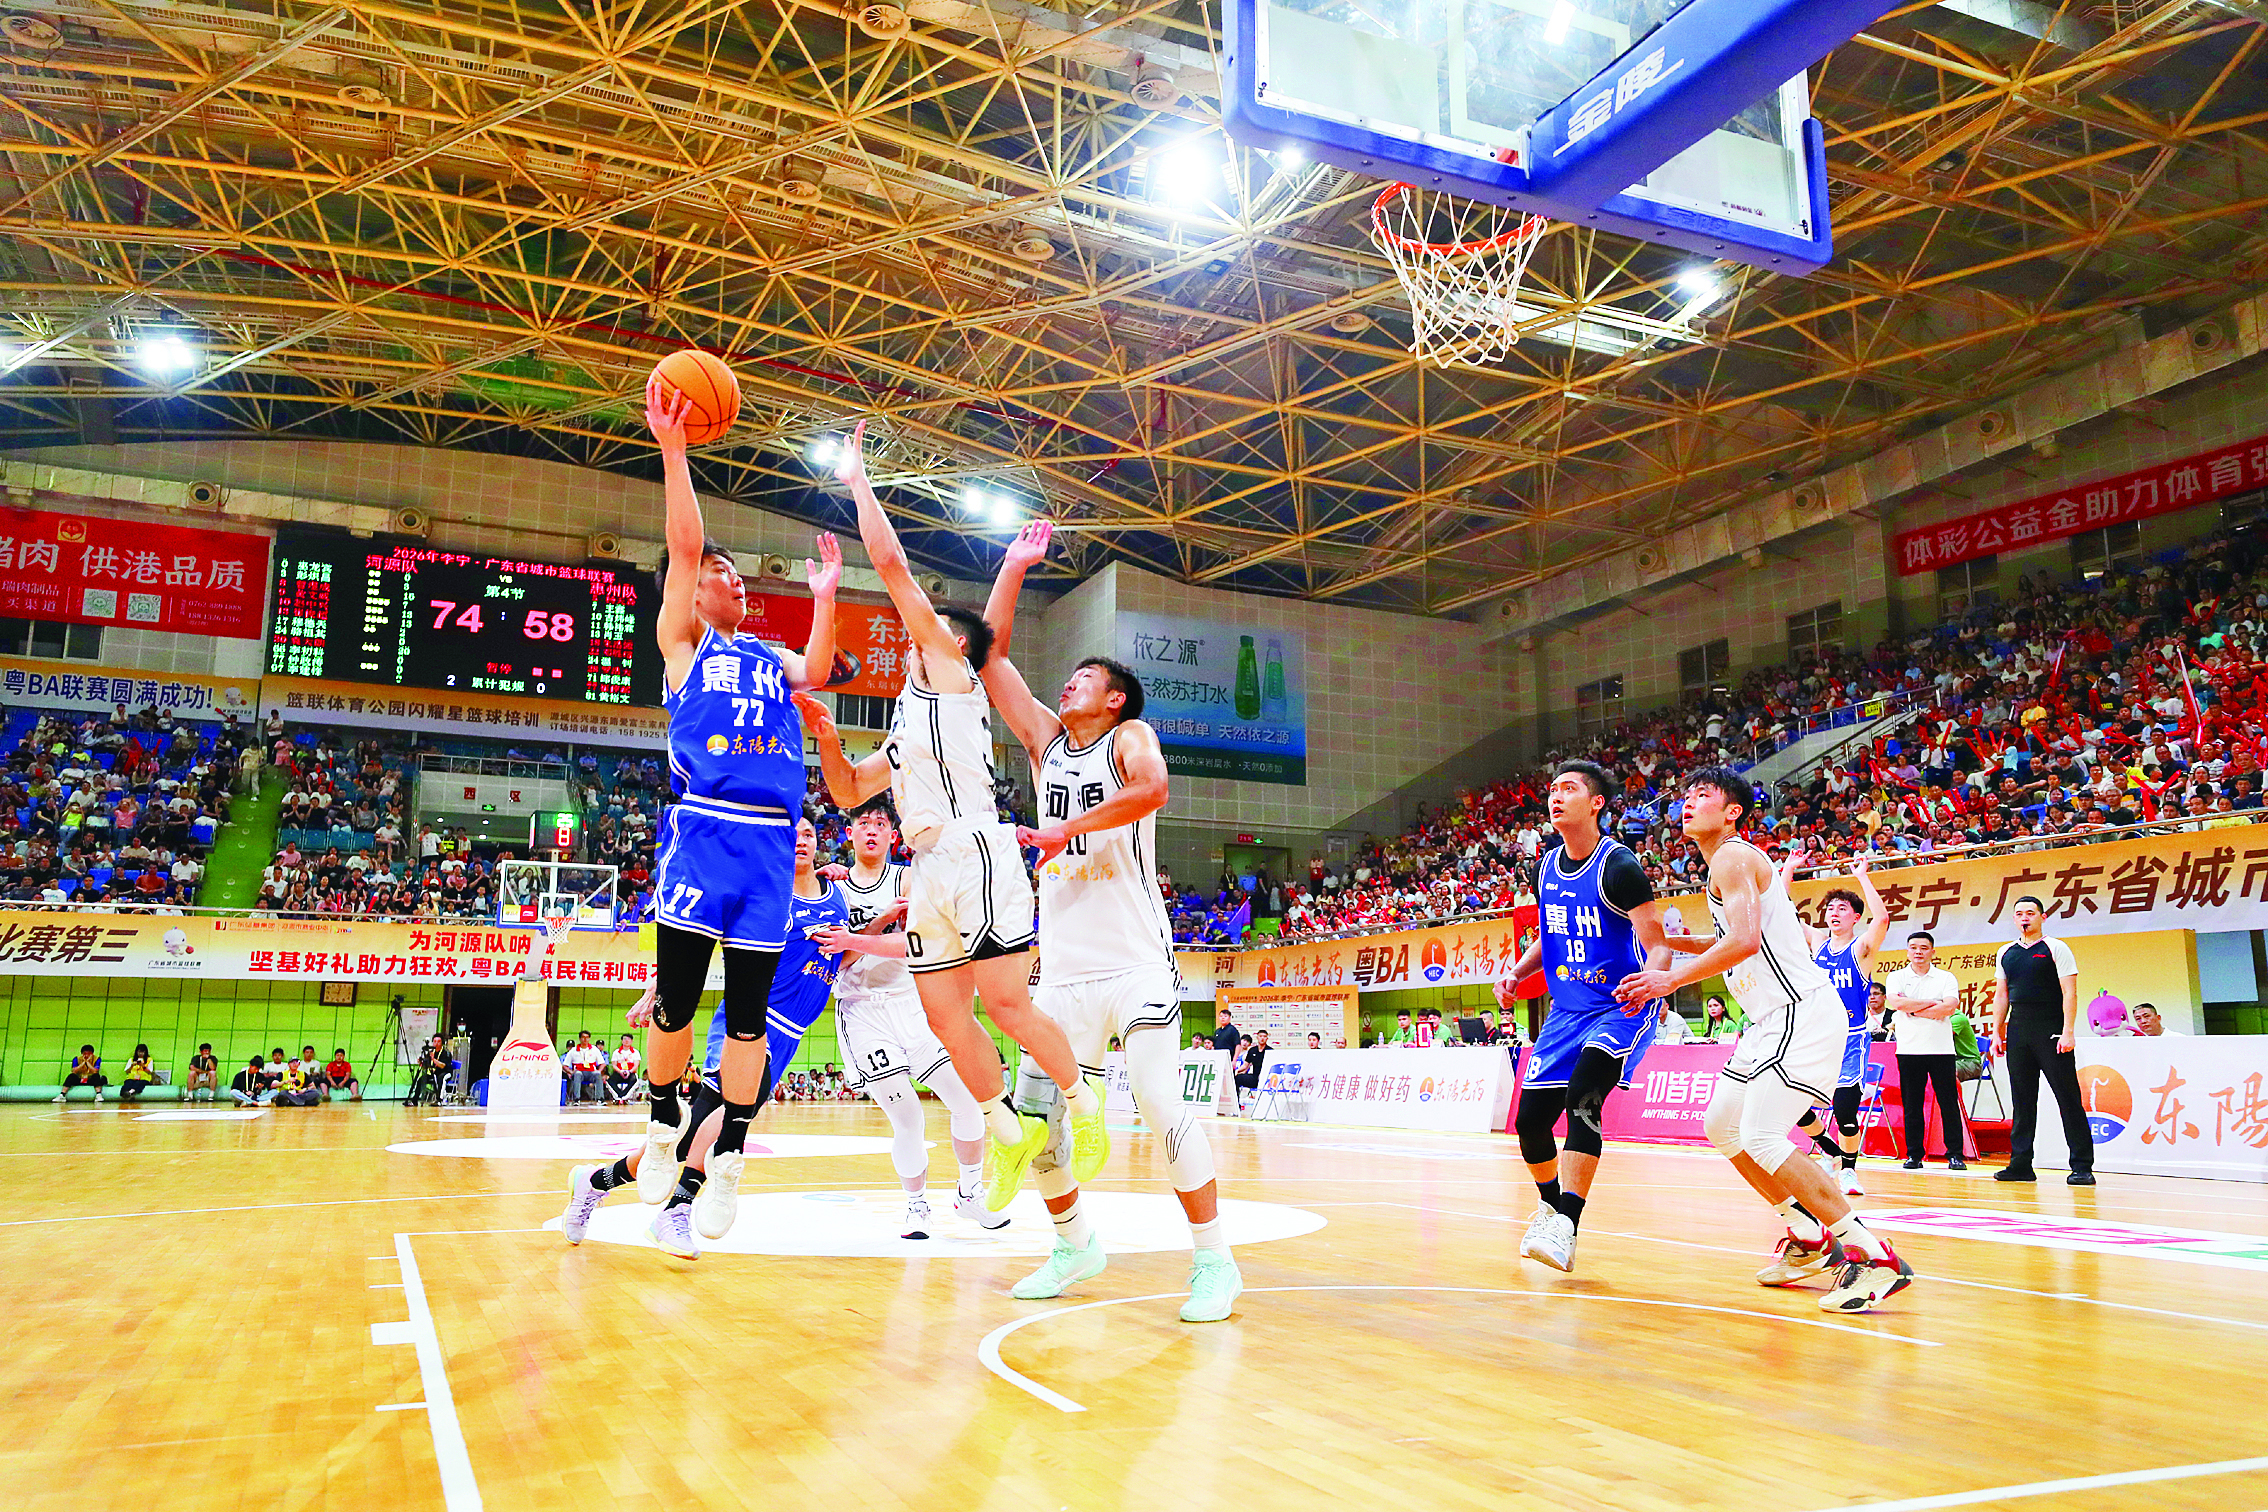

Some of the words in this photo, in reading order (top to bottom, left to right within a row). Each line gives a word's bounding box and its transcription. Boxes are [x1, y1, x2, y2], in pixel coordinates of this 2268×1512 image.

[79, 544, 245, 593] 供港品质
[365, 554, 419, 574] 河源队
[484, 585, 525, 600] 第4节
[430, 600, 484, 633] 74
[523, 610, 574, 642] 58
[1133, 632, 1199, 666] 依之源
[3, 669, 213, 709] 粤BA联赛圆满成功!
[447, 674, 456, 686] 2
[536, 682, 546, 693] 0
[702, 653, 784, 703] 惠州
[286, 691, 540, 728] 篮联体育公园闪耀星篮球培训
[550, 712, 669, 731] 源城区兴源东路爱富兰家具
[732, 698, 764, 726] 77
[619, 728, 635, 737] 158
[639, 730, 660, 739] 1925
[1140, 716, 1210, 737] 康很碱单
[1219, 724, 1290, 745] 天然依之源
[664, 883, 703, 918] 77
[1544, 904, 1602, 938] 惠州
[1566, 939, 1586, 963] 18
[1877, 953, 1997, 973] 2026宁·广东省城
[1352, 944, 1409, 987] 粤BA
[1428, 968, 1440, 977] HEC
[502, 1054, 549, 1062] LI-NING
[868, 1048, 889, 1071] 13
[1180, 1064, 1216, 1102] 卫仕
[1318, 1073, 1361, 1101] 为健康
[1364, 1074, 1412, 1102] 做好药
[1629, 1070, 1721, 1105] 一切皆有
[1641, 1108, 1680, 1120] ANYTHING
[1680, 1110, 1691, 1120] IS
[2091, 1123, 2109, 1137] EC
